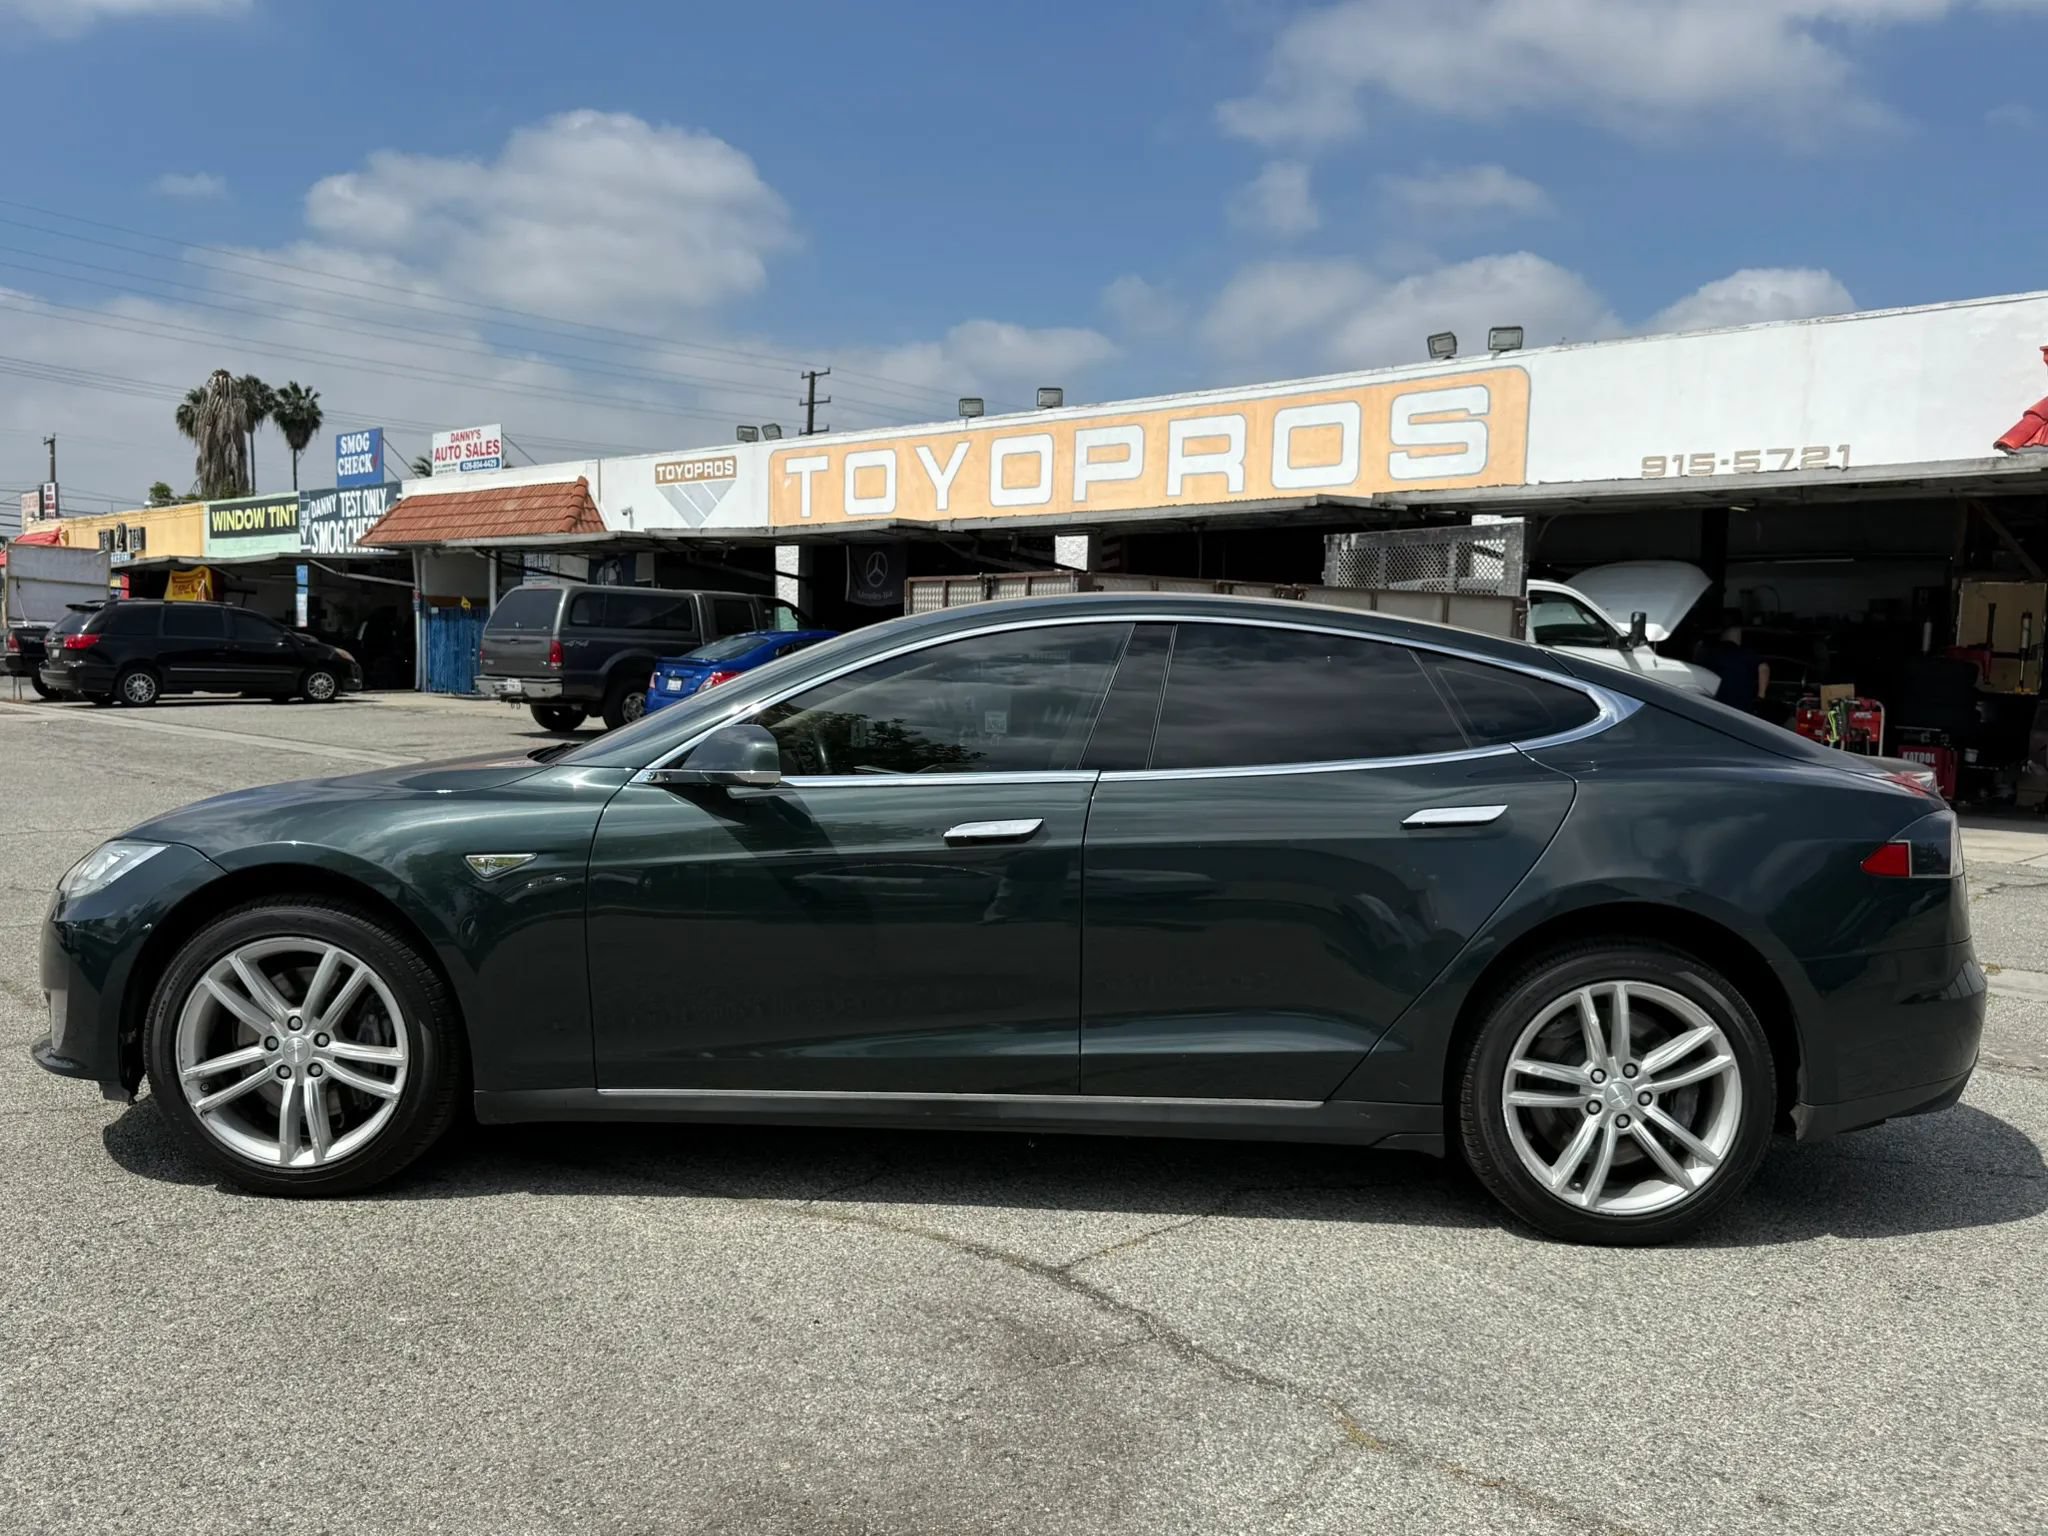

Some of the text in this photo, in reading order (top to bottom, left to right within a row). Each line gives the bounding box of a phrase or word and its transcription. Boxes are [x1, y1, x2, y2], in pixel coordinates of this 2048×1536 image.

[340, 432, 370, 454] SMOG
[450, 429, 481, 443] DANNY'S
[434, 439, 500, 462] AUTO SALES
[785, 385, 1491, 519] TOYOPROS
[1641, 444, 1850, 478] 915-5721
[337, 453, 373, 476] CHECK
[656, 460, 734, 480] TOYOPROS
[311, 494, 337, 518] DANNY
[339, 490, 361, 518] TEST
[363, 487, 387, 517] ONLY
[212, 507, 266, 532] WINDOW
[267, 503, 298, 527] TINT
[311, 519, 345, 554] SMOG
